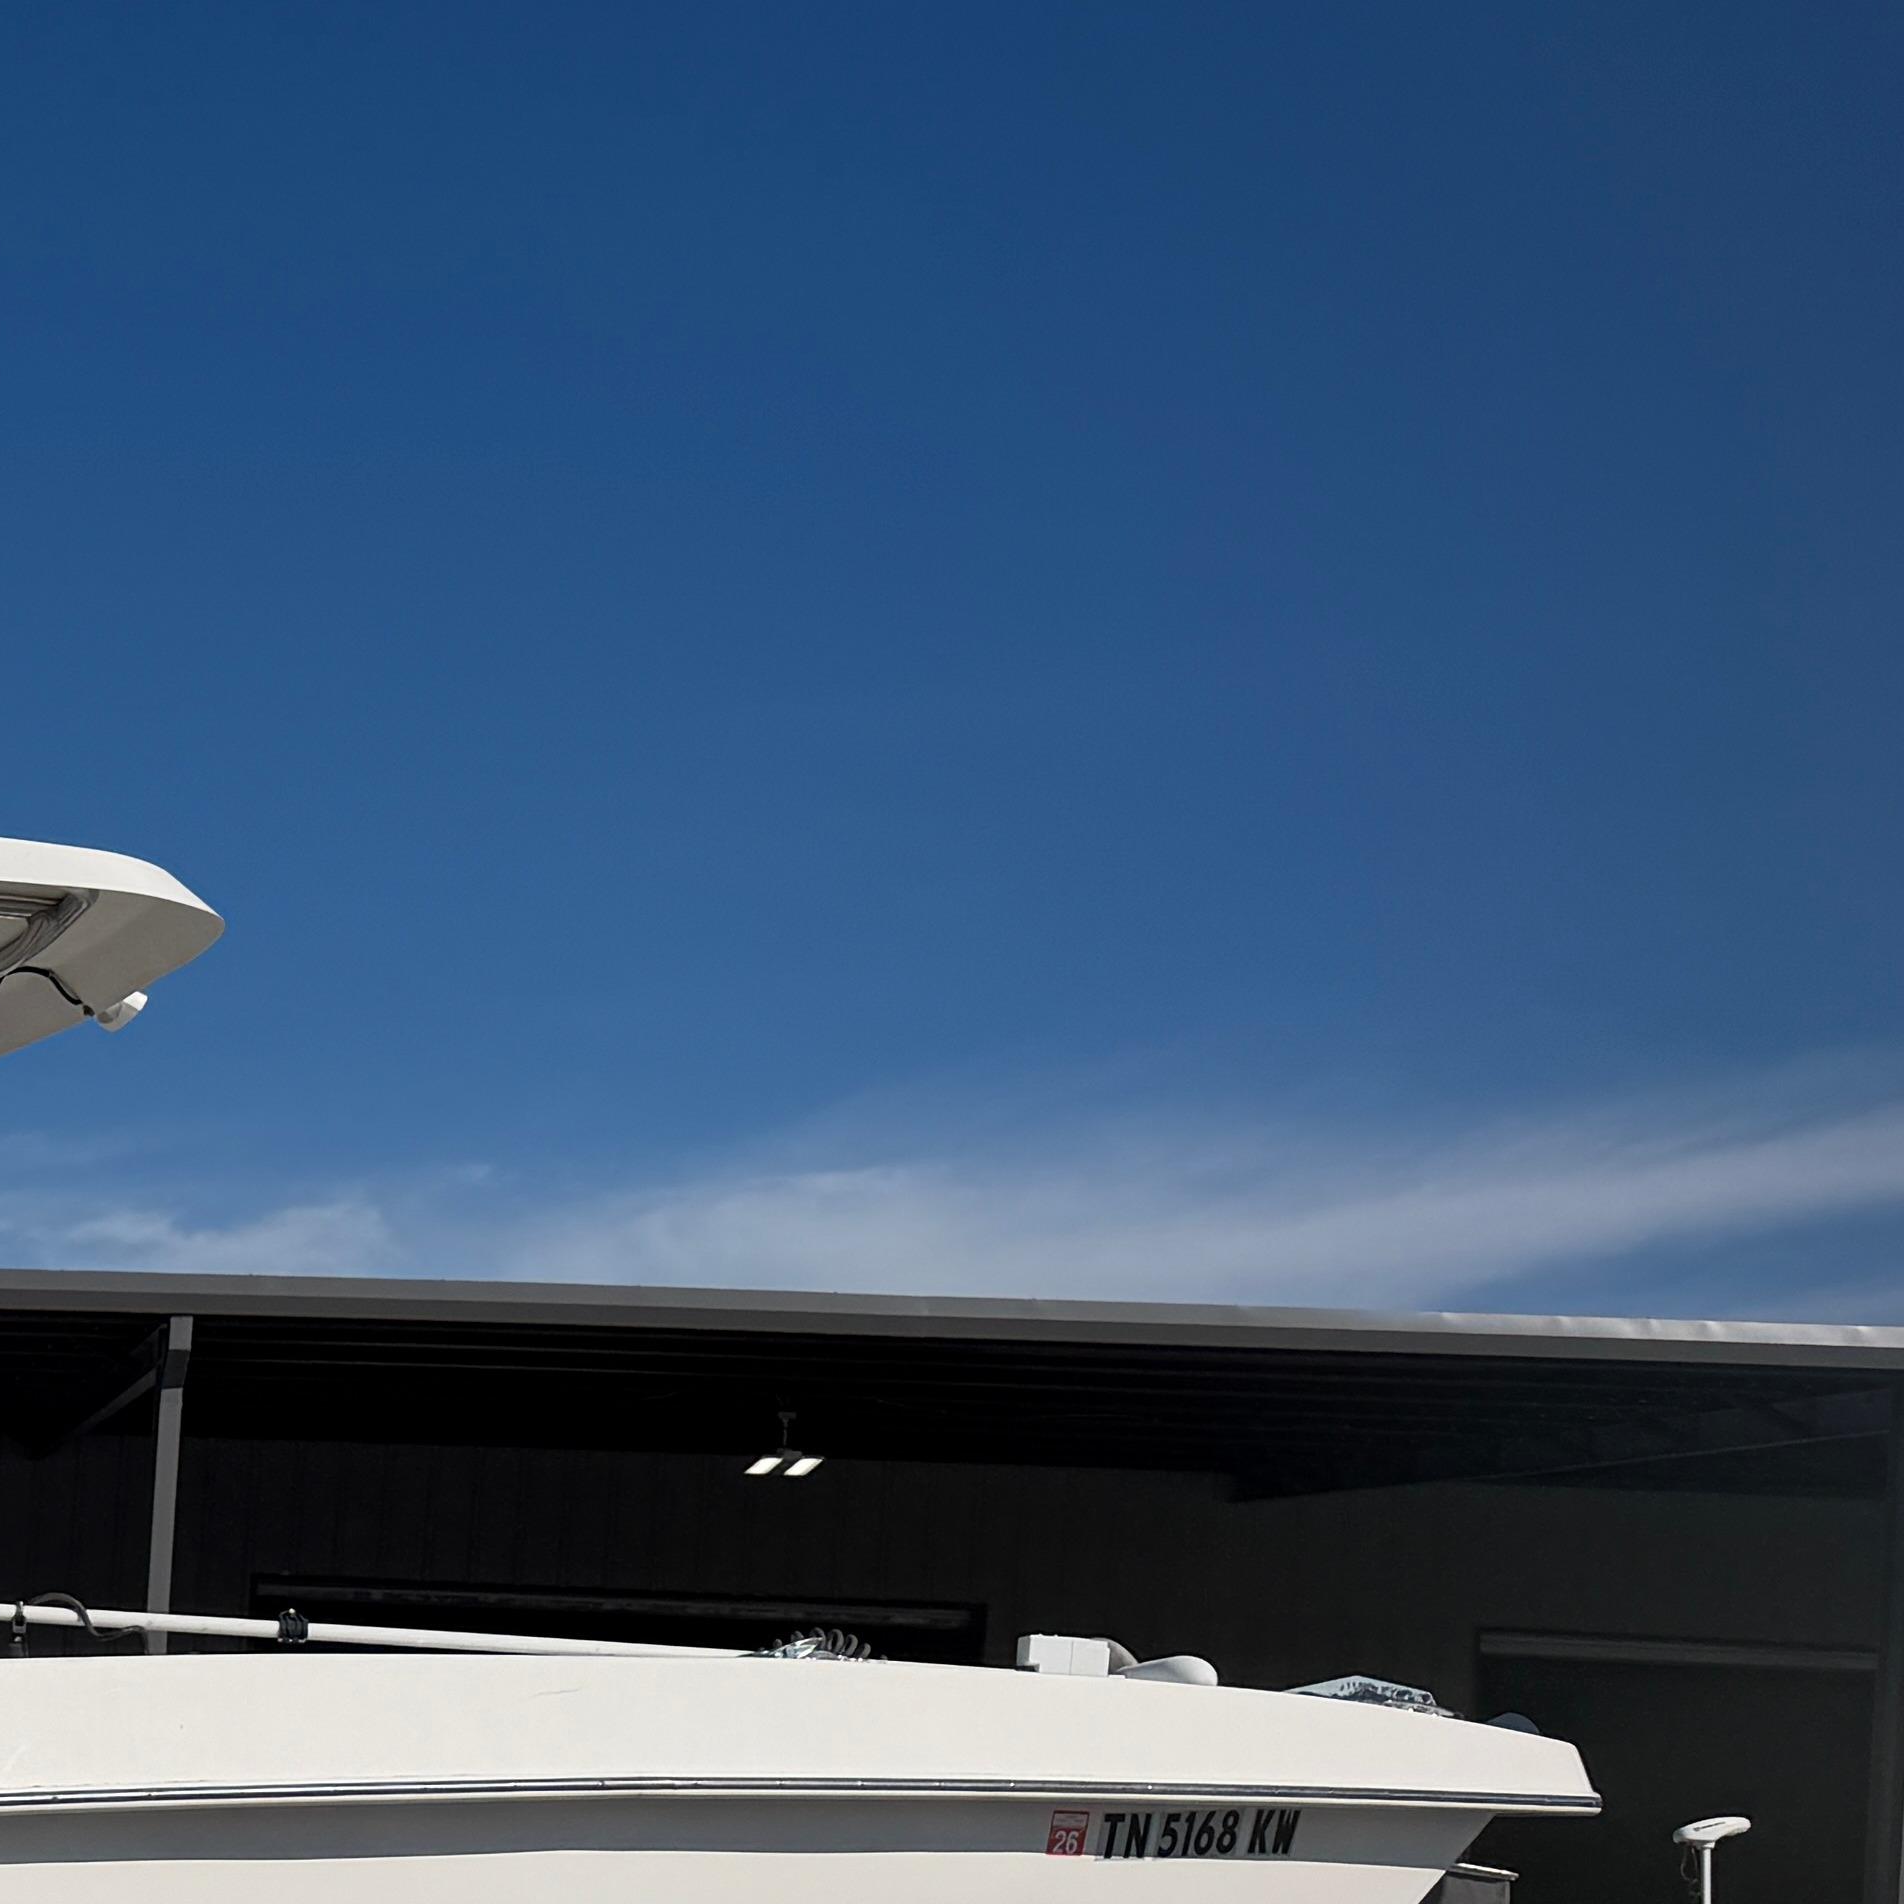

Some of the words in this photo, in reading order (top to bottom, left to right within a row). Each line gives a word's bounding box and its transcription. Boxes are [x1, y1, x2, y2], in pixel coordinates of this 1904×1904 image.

[1052, 1830, 1080, 1854] 26
[1103, 1812, 1153, 1859] TN
[1156, 1810, 1240, 1858] 5168
[1247, 1808, 1301, 1855] KW
